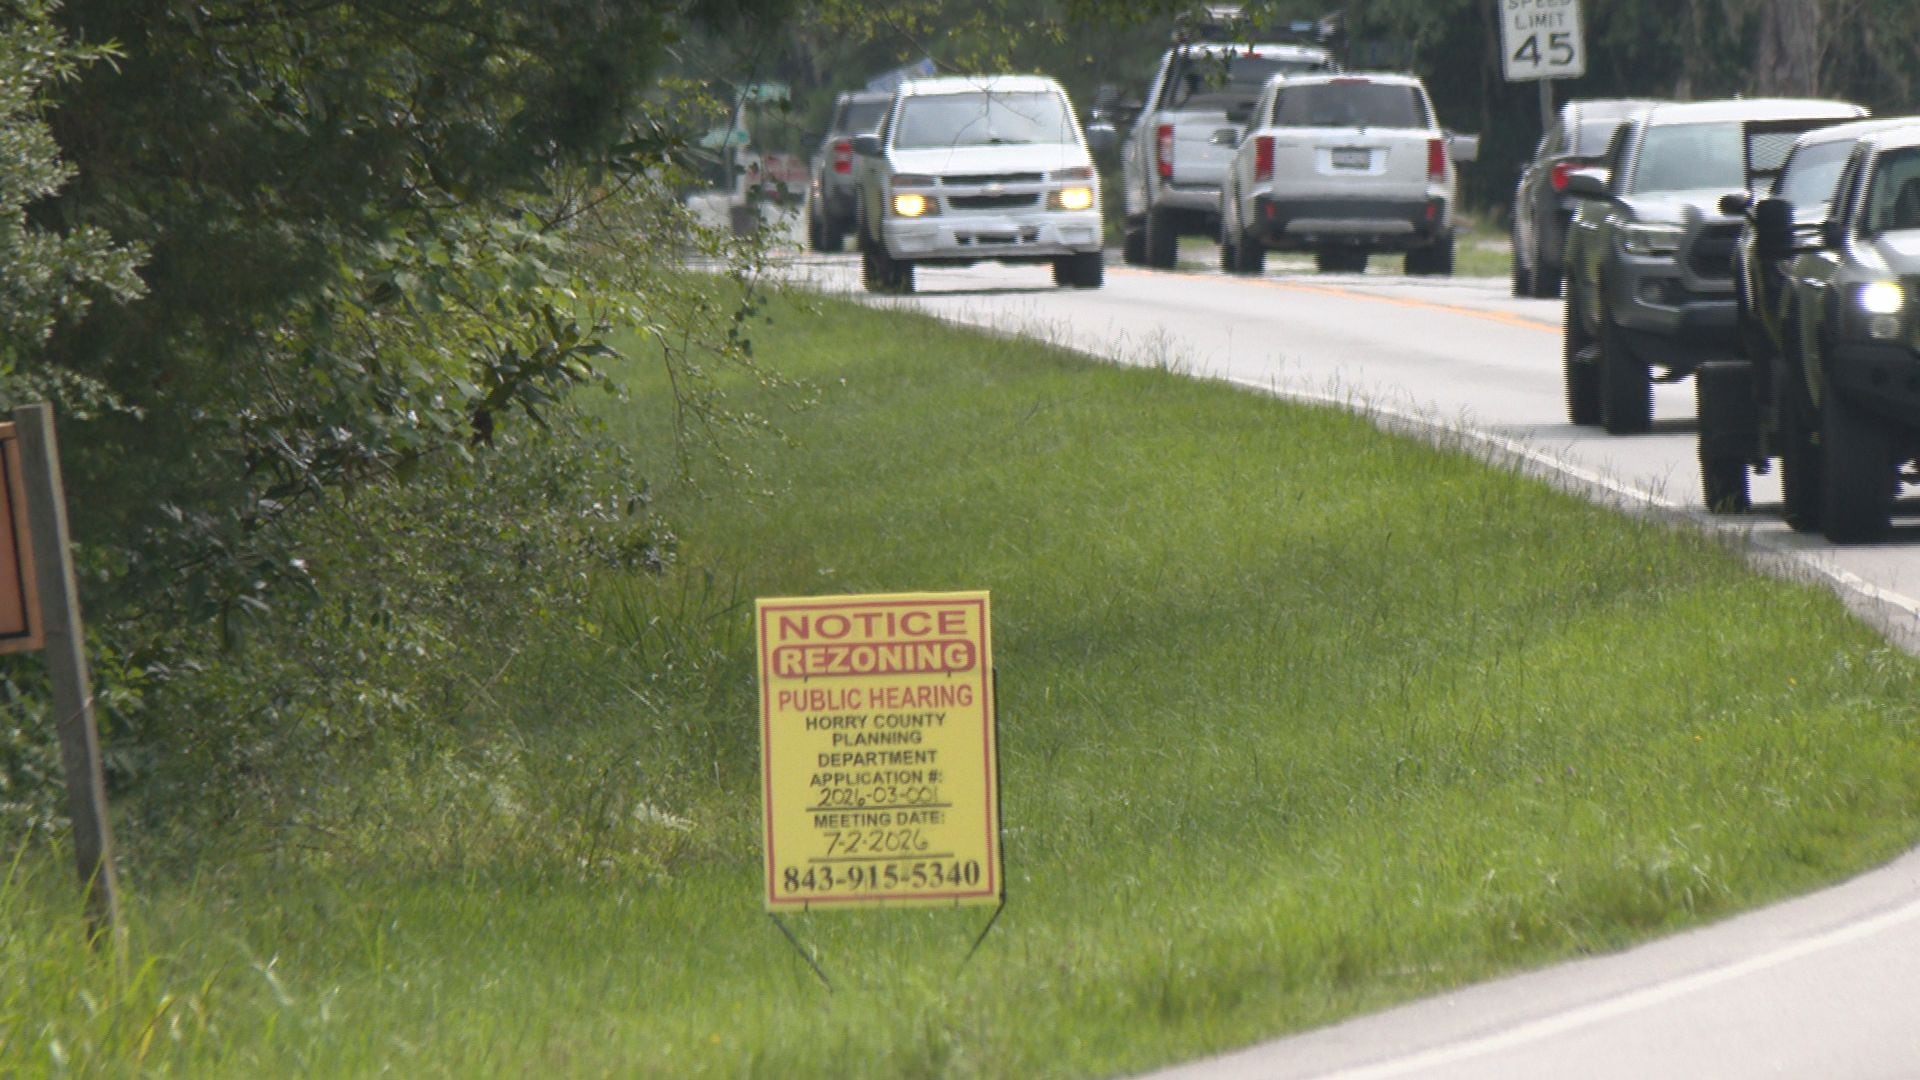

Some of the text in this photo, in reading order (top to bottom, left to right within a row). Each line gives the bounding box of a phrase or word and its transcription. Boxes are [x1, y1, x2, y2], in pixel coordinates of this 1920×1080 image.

[1514, 13, 1563, 29] LIMIT
[1512, 32, 1574, 67] 45
[779, 610, 967, 640] NOTICE
[780, 643, 969, 674] REZONING
[778, 684, 973, 712] PUBLIC HEARING
[806, 713, 946, 730] HORRY COUNTY
[832, 731, 922, 747] PLANNING
[818, 750, 937, 768] DEPARTMENT
[810, 769, 943, 786] APPLICATION #:
[814, 810, 945, 828] MEETING DATE:
[784, 861, 979, 892] 843-915-5340
